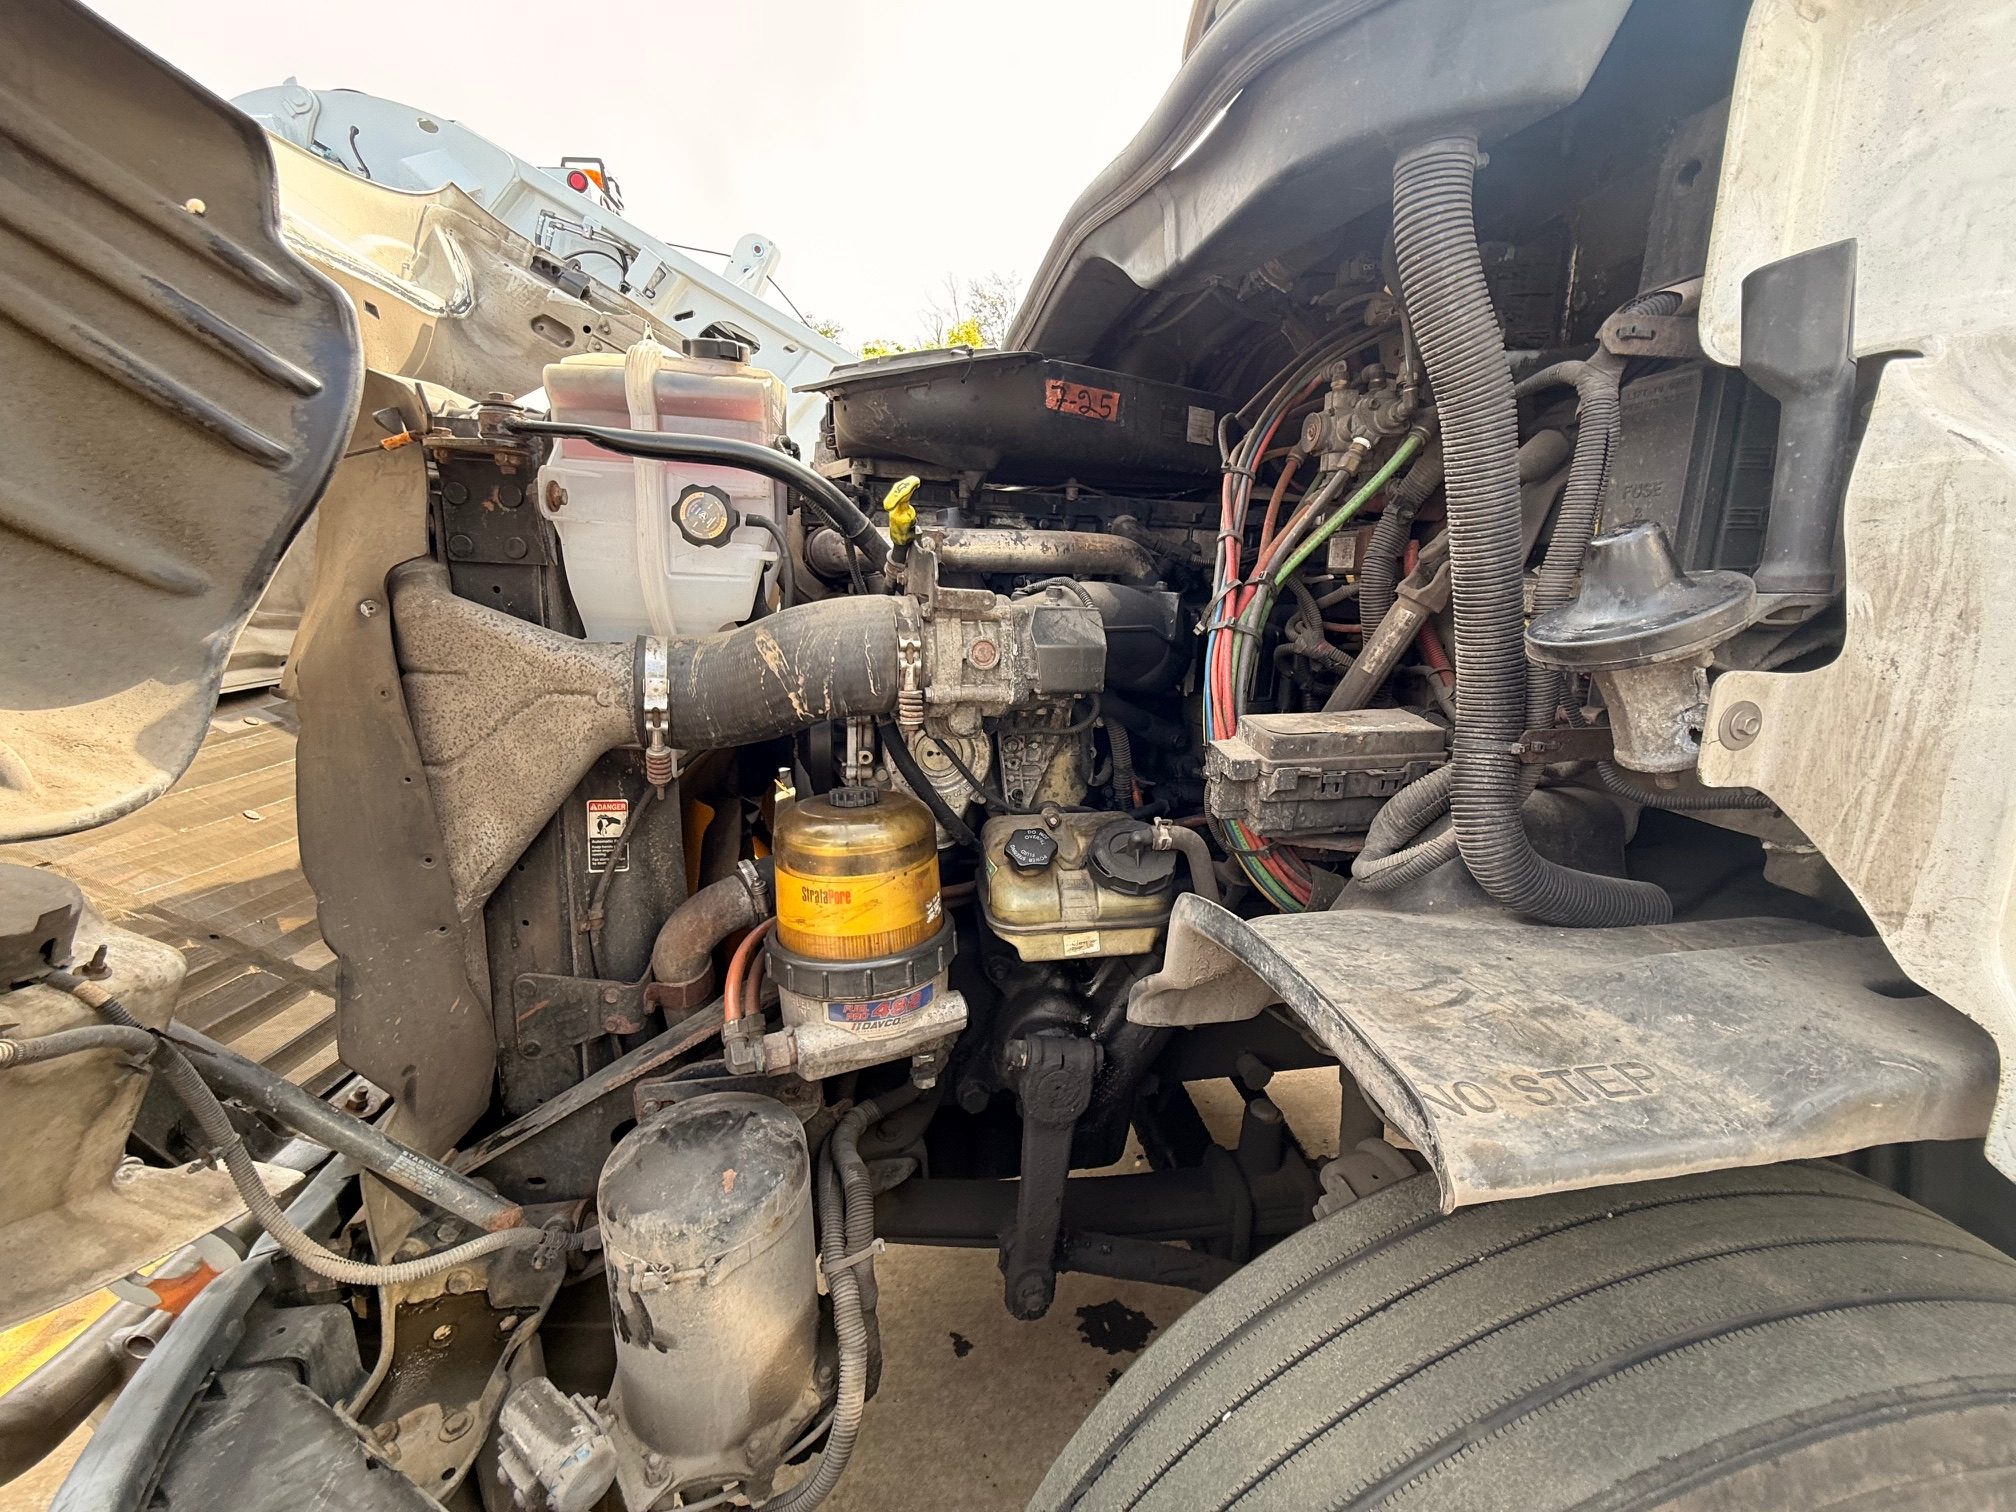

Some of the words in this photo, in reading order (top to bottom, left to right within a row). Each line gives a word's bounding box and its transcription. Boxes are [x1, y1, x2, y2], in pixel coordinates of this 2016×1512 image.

[1051, 384, 1113, 418] 7-25
[1622, 480, 1664, 499] FUSE
[597, 803, 626, 811] DANGER
[1038, 831, 1050, 840] NOT
[1020, 849, 1035, 857] FLUID
[801, 886, 852, 905] StrataPore
[843, 1004, 869, 1013] FUEL
[871, 991, 922, 1018] 482
[845, 1012, 869, 1021] PRO
[861, 1017, 901, 1031] DAVCO
[1417, 1080, 1498, 1119] NO
[1509, 1061, 1656, 1107] STEP
[401, 1150, 446, 1176] STABILUS
